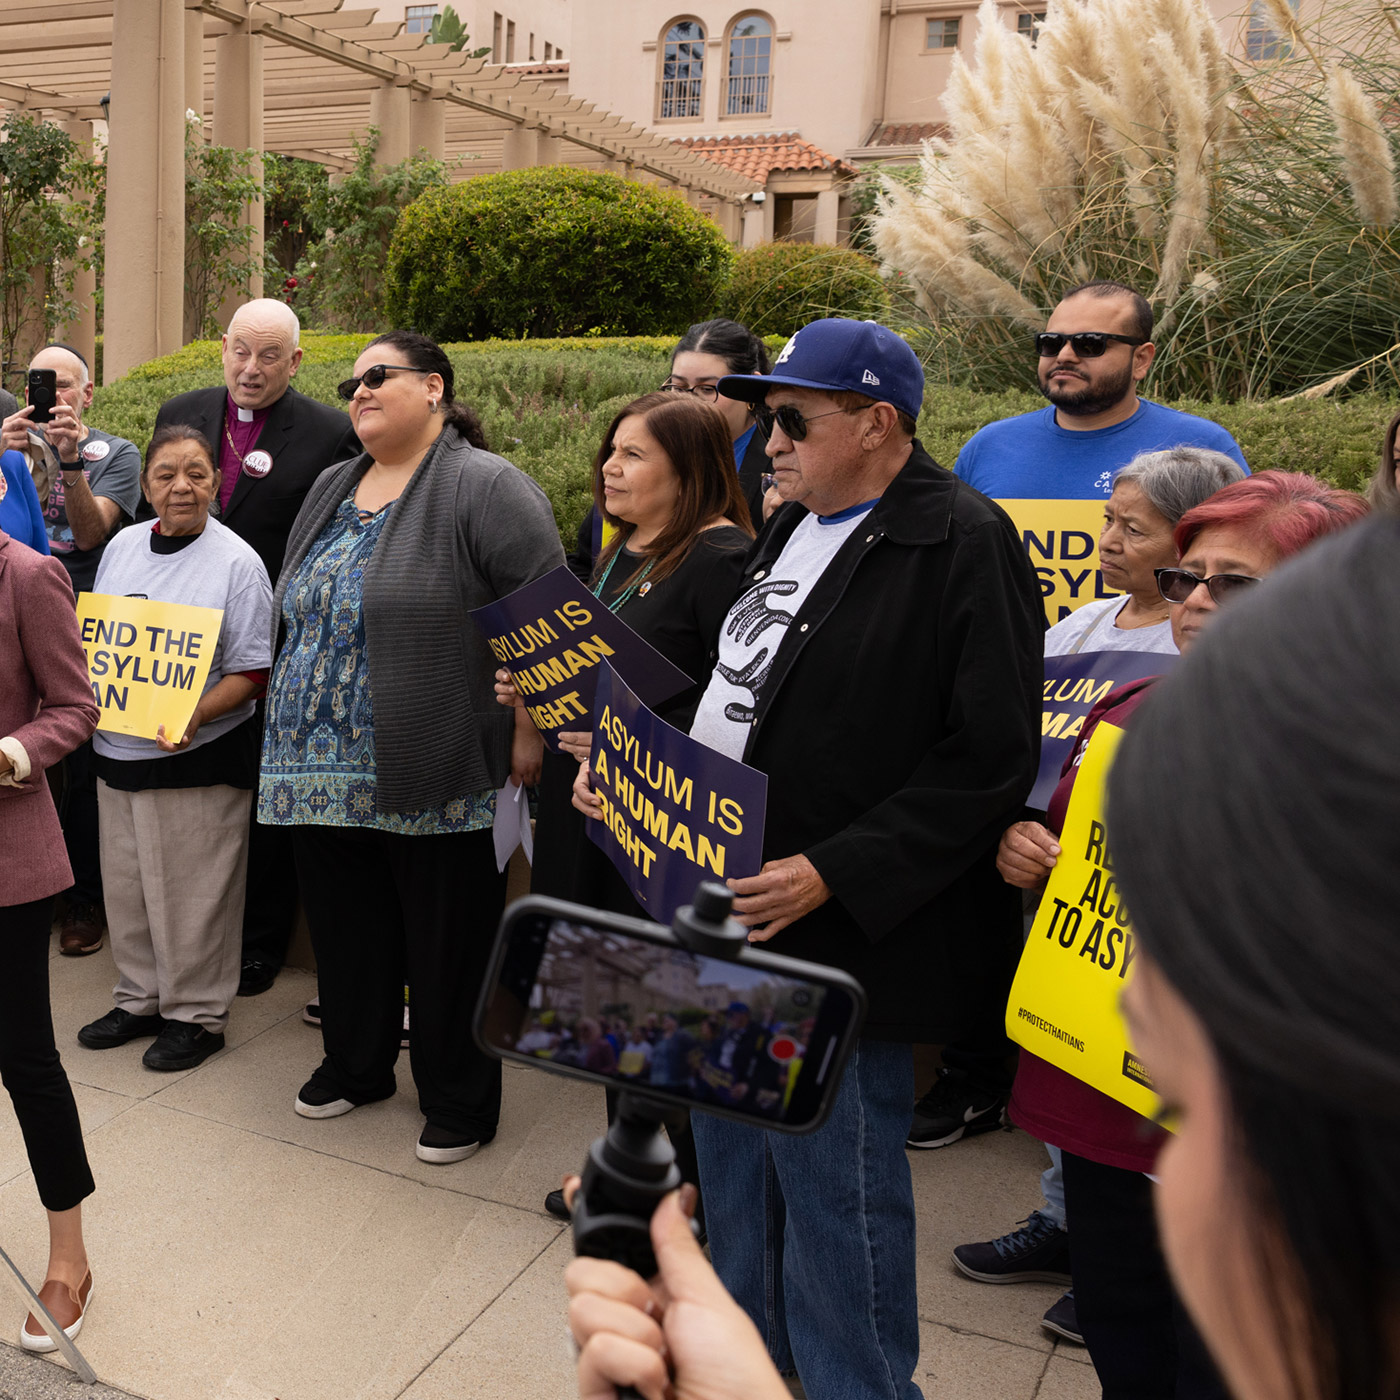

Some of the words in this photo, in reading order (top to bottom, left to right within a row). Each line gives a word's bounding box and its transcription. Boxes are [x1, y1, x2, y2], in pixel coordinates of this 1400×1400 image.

[554, 600, 592, 632] IS
[730, 590, 758, 614] WELCOME
[759, 584, 774, 594] WITH
[774, 584, 797, 592] DIGNITY
[82, 617, 138, 648] END
[146, 626, 203, 659] THE
[84, 648, 196, 690] SYLUM
[514, 634, 616, 695] HUMAN
[599, 704, 694, 812] ASYLUM
[708, 790, 744, 836] IS
[595, 748, 610, 786] A
[616, 766, 726, 878] HUMAN
[595, 786, 656, 878] RIGHT
[1046, 897, 1083, 948] TO
[1018, 1006, 1085, 1053] #PROTECTHAITIANS
